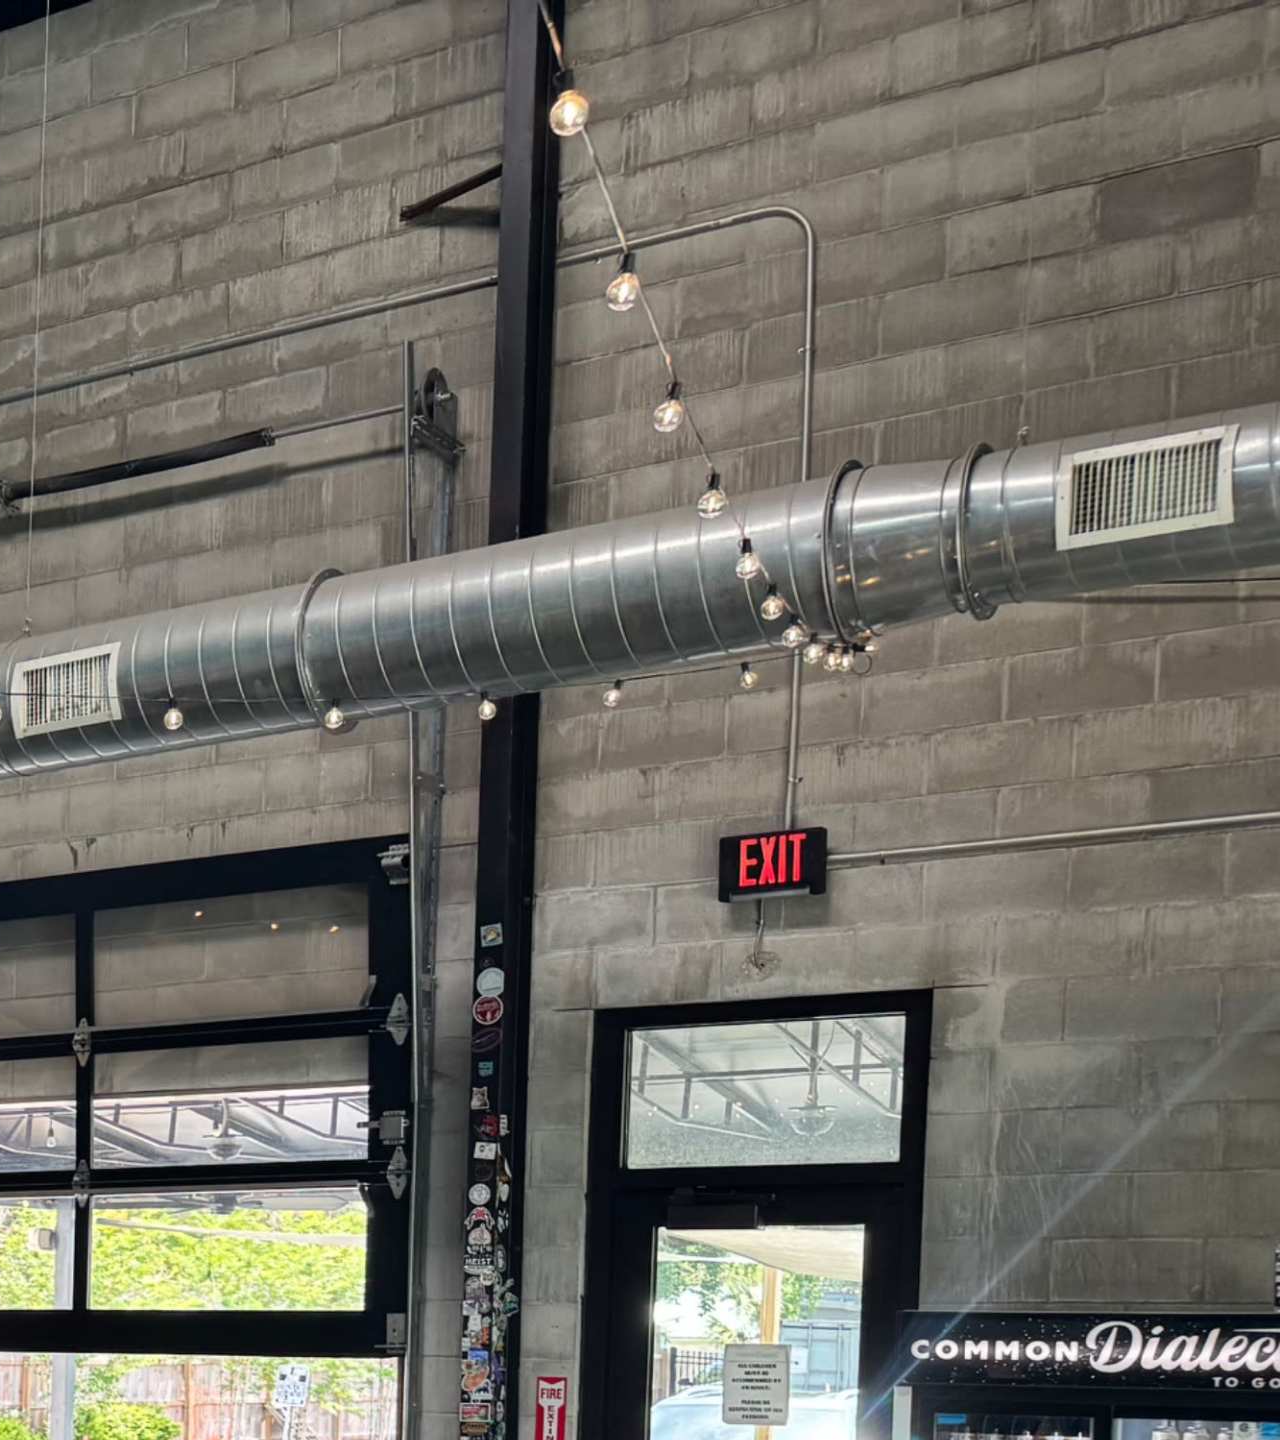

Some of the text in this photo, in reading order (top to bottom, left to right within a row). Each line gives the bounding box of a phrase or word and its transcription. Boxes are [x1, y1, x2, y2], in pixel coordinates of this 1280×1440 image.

[739, 832, 807, 888] EXIT
[465, 1257, 492, 1265] HEIST
[910, 1320, 1280, 1373] COMMON Dialec
[1212, 1376, 1280, 1389] TO GO
[540, 1387, 563, 1400] FIRE
